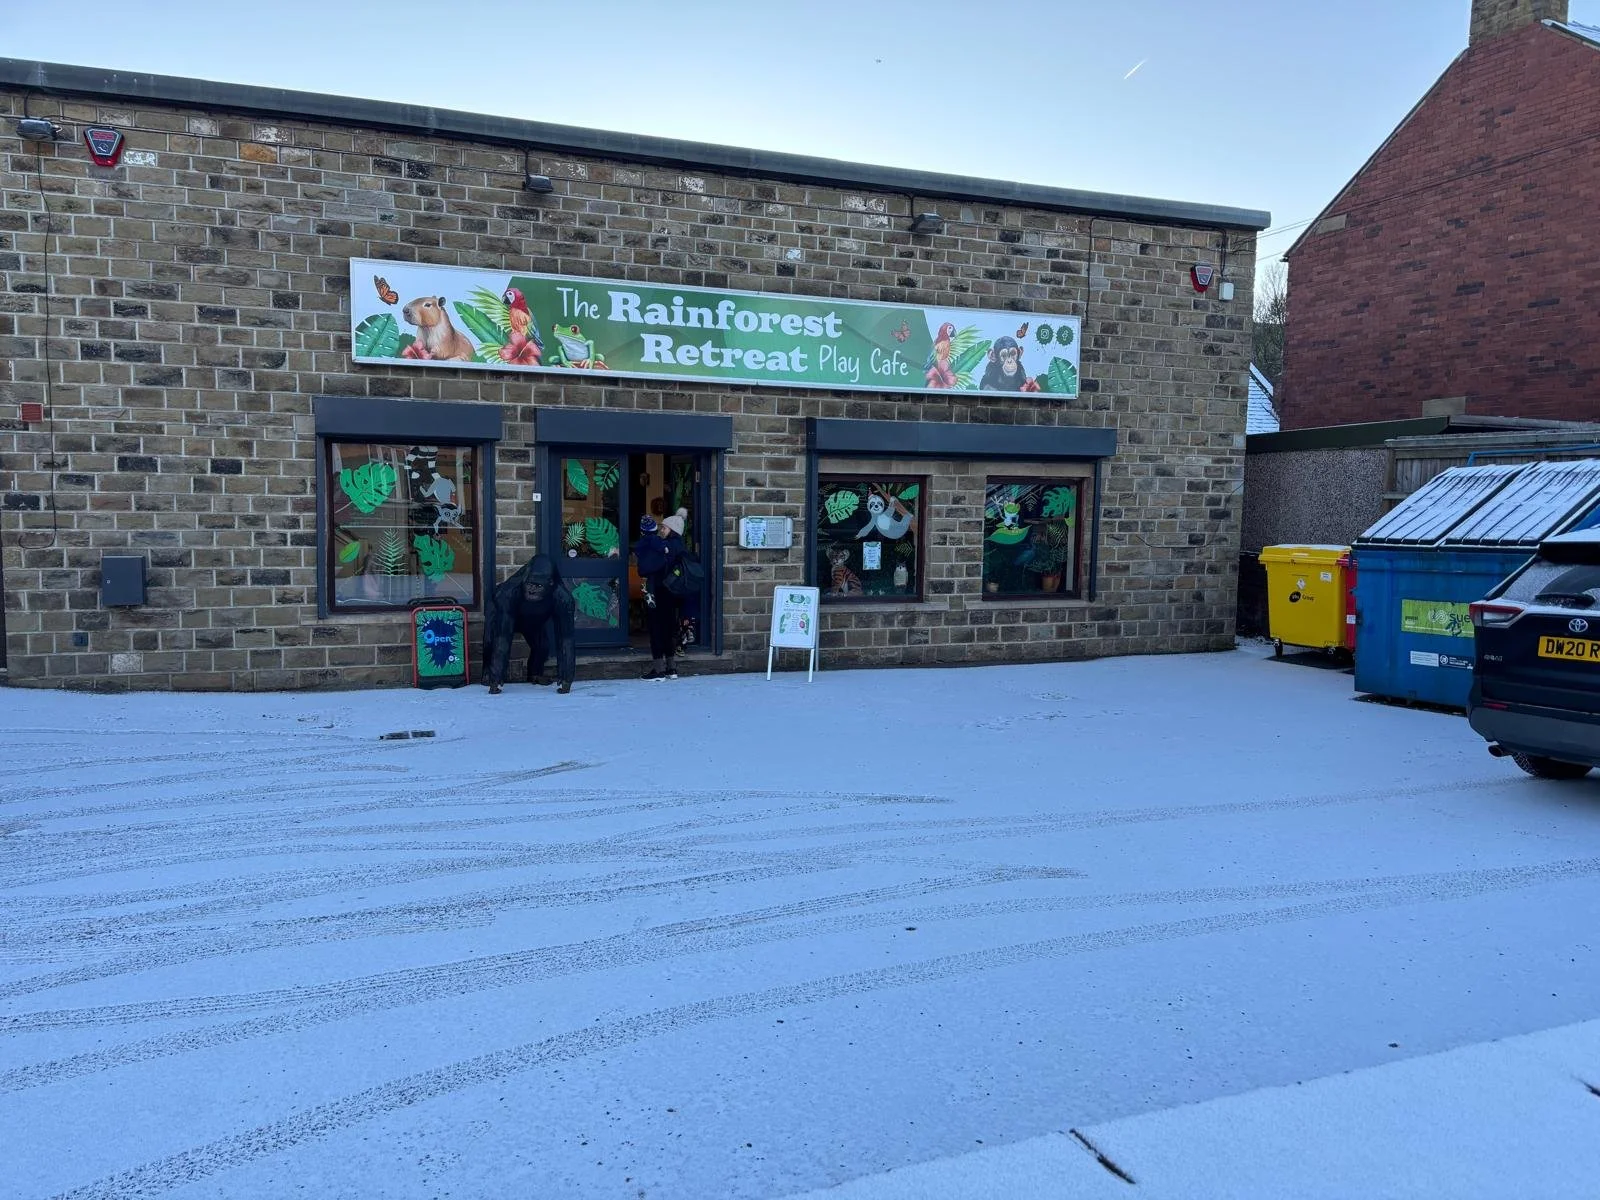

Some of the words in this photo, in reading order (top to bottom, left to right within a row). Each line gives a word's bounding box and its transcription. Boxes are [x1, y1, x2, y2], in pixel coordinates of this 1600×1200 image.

[556, 287, 600, 319] The
[607, 291, 842, 338] Rainforest
[640, 333, 808, 373] Retreat
[819, 344, 860, 383] Play
[870, 347, 909, 376] Cafe
[424, 629, 453, 646] Open
[1545, 638, 1586, 657] DW20
